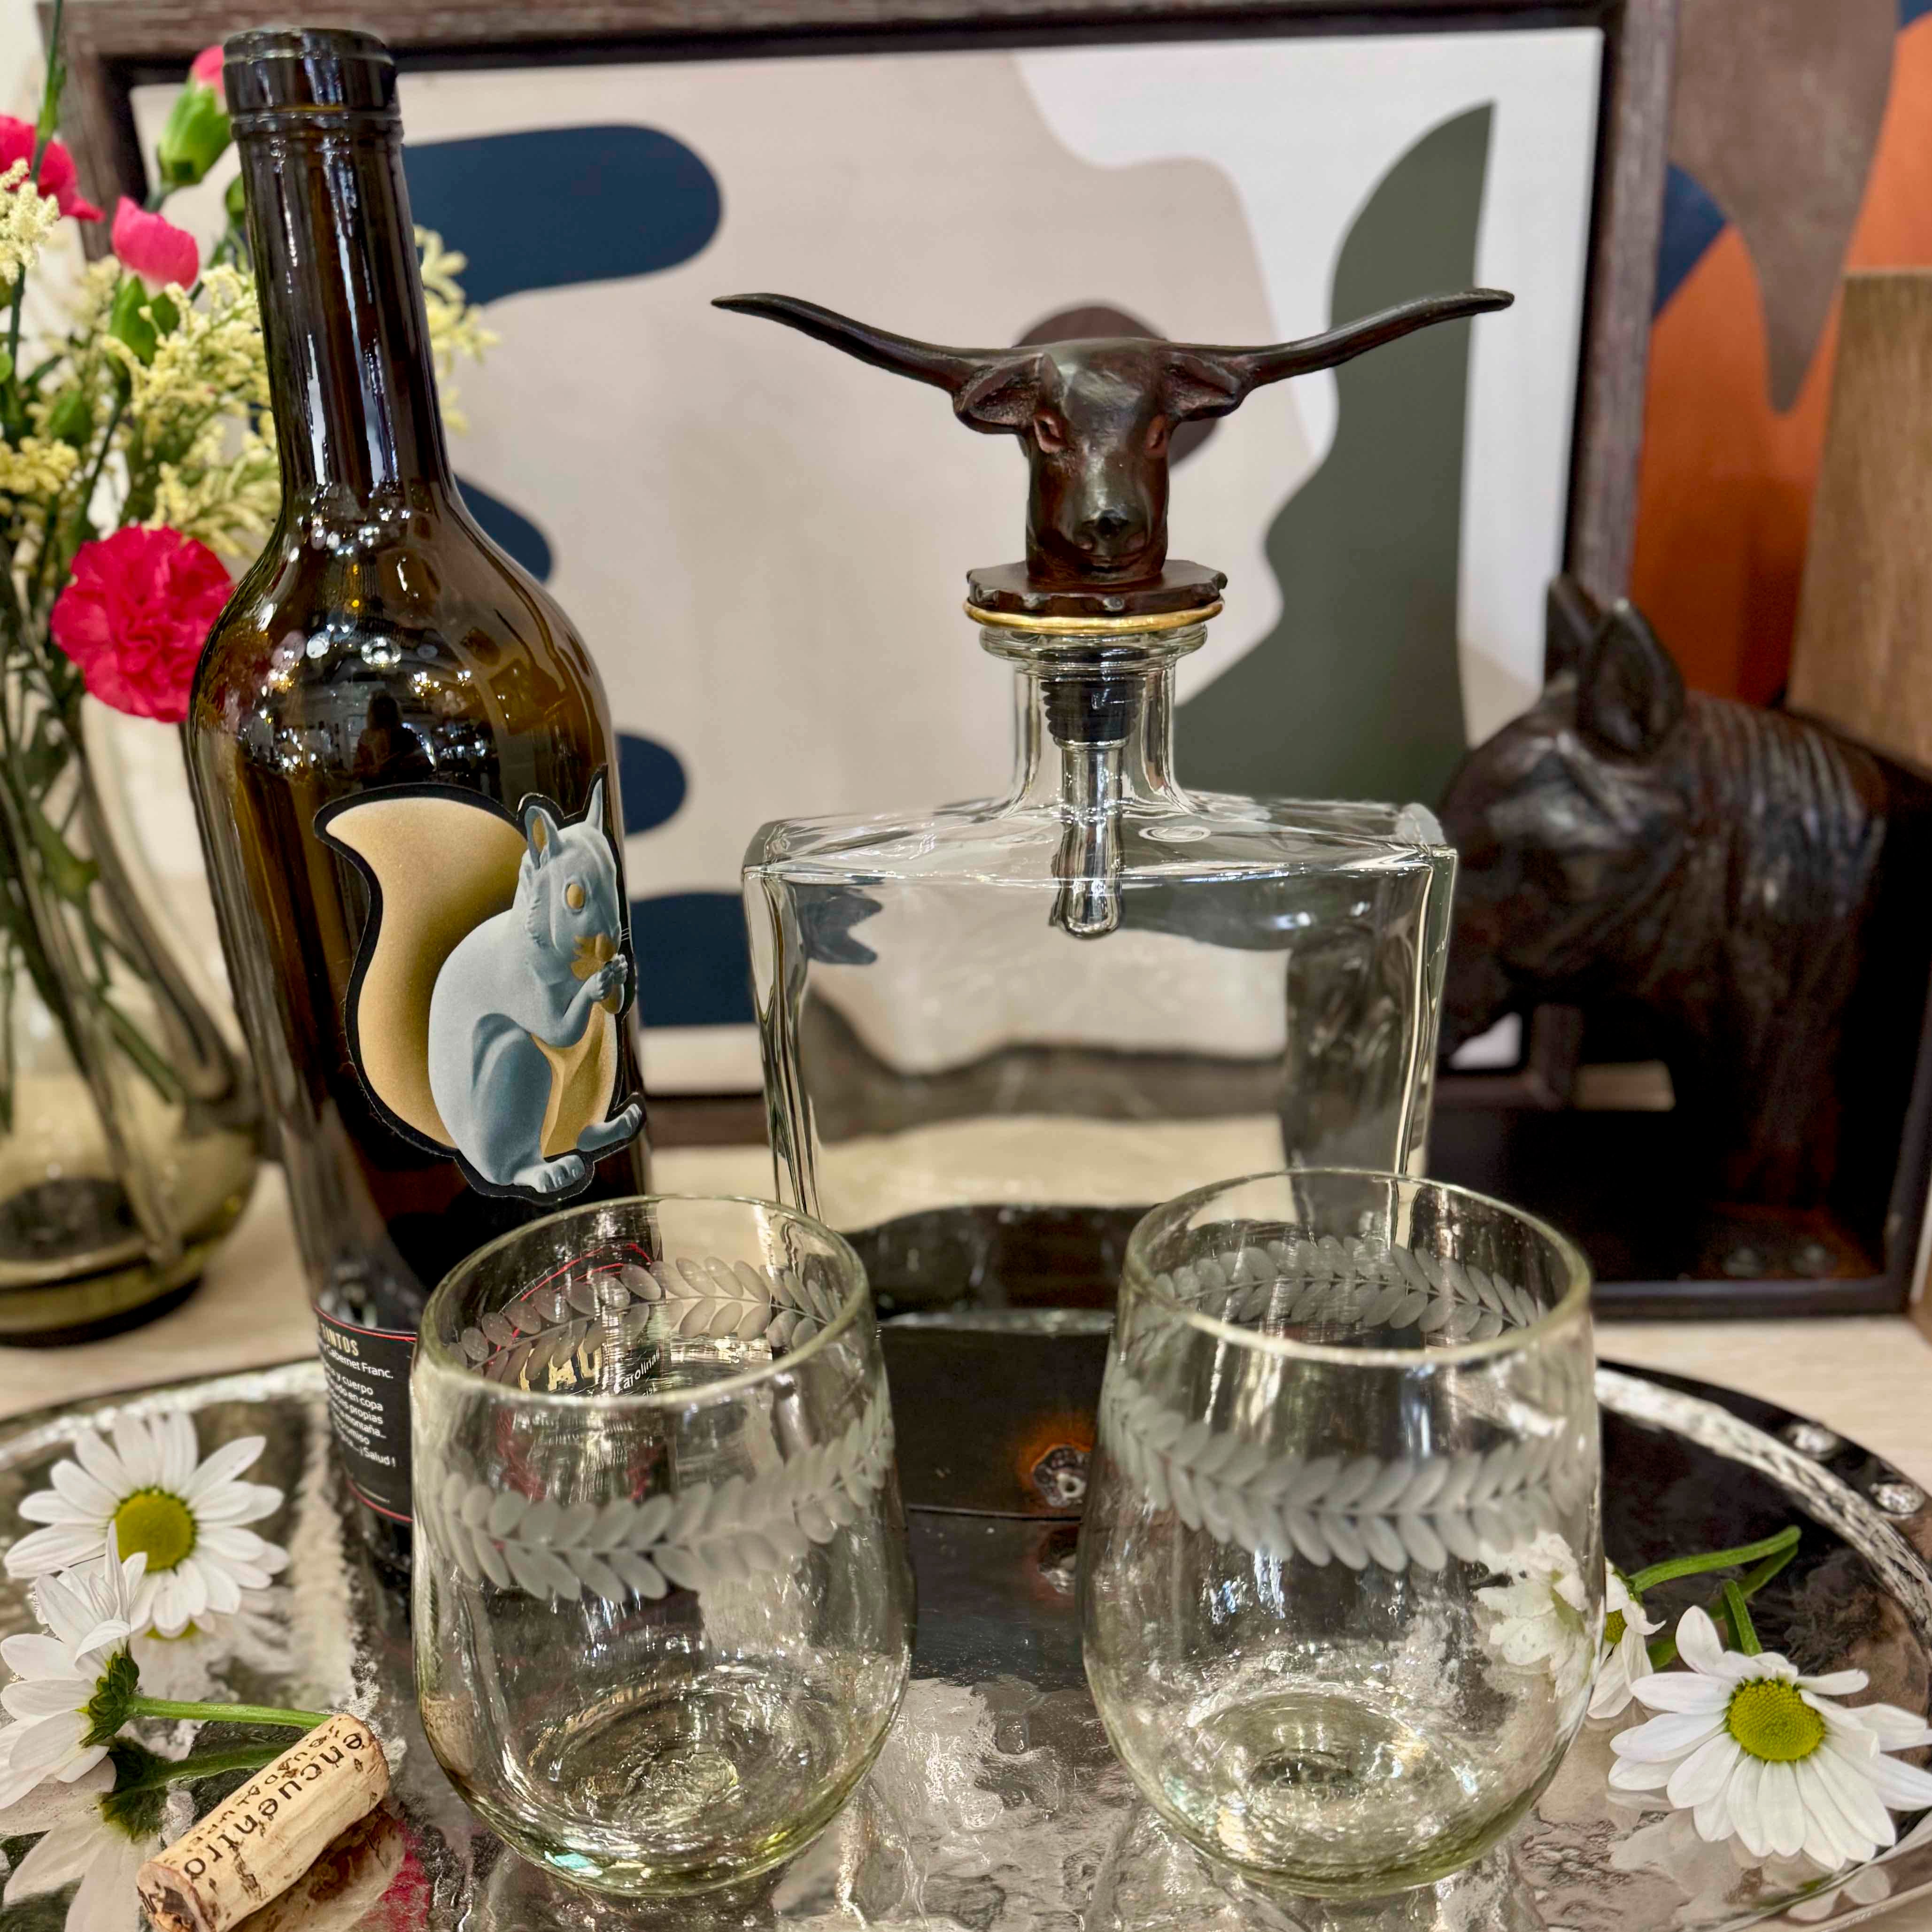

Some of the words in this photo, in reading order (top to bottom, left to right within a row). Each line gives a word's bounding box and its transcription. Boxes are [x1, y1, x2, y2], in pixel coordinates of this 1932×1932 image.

[361, 1362, 394, 1379] Franc.
[342, 1376, 374, 1396] cuerpo
[348, 1391, 359, 1403] en
[359, 1397, 384, 1412] copa
[349, 1405, 384, 1425] propias
[184, 1732, 364, 1878] encuentro
